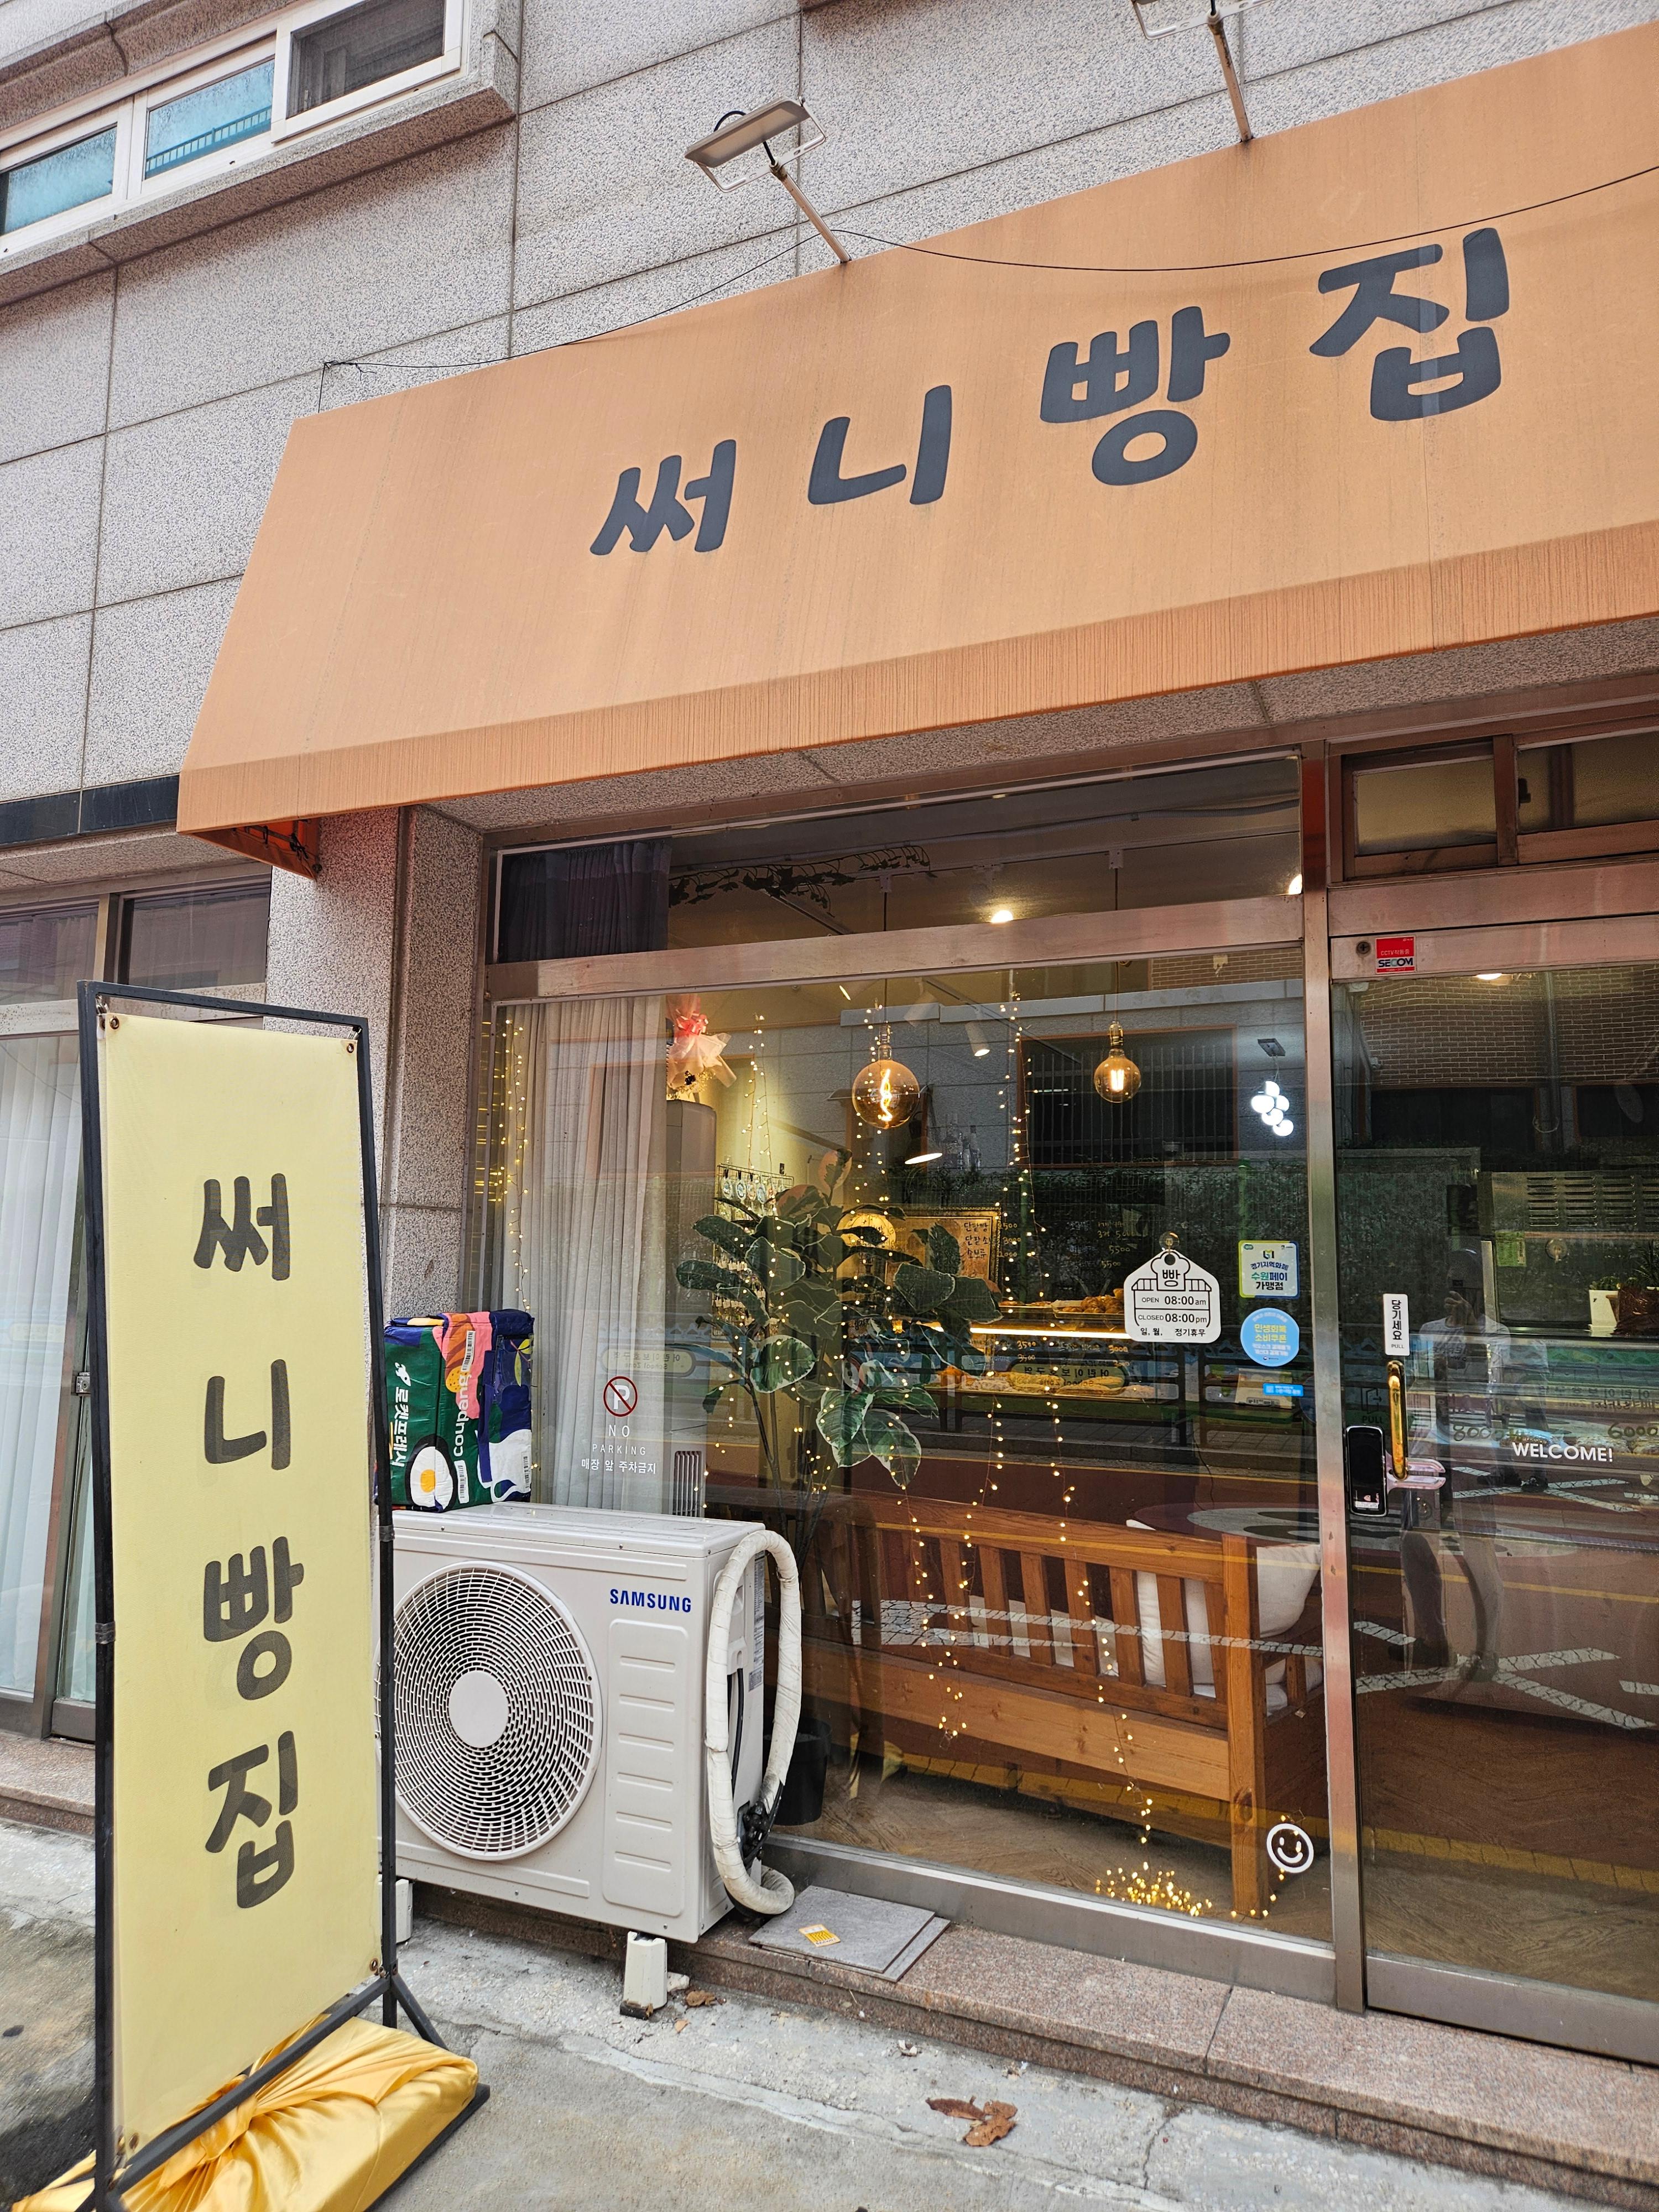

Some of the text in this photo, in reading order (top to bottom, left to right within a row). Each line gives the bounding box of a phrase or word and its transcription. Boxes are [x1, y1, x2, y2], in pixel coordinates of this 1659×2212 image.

[1378, 957, 1413, 968] SECOM
[1162, 1269, 1181, 1287] 빵
[1251, 1272, 1287, 1281] 수원페이
[1256, 1281, 1284, 1291] 가맹점
[1164, 1296, 1194, 1305] 08:00
[1165, 1313, 1194, 1323] 08:00
[1391, 1300, 1402, 1340] 당기세요
[1175, 1328, 1206, 1337] 정기휴무
[453, 1374, 472, 1457] coupang
[391, 1386, 409, 1467] 로켓프레시
[608, 1424, 630, 1437] NO
[592, 1443, 646, 1455] PARKING
[1512, 1442, 1613, 1462] WELCOME!
[581, 1458, 656, 1474] 매장 앞 주차금지
[610, 1589, 691, 1613] SAMSUNG
